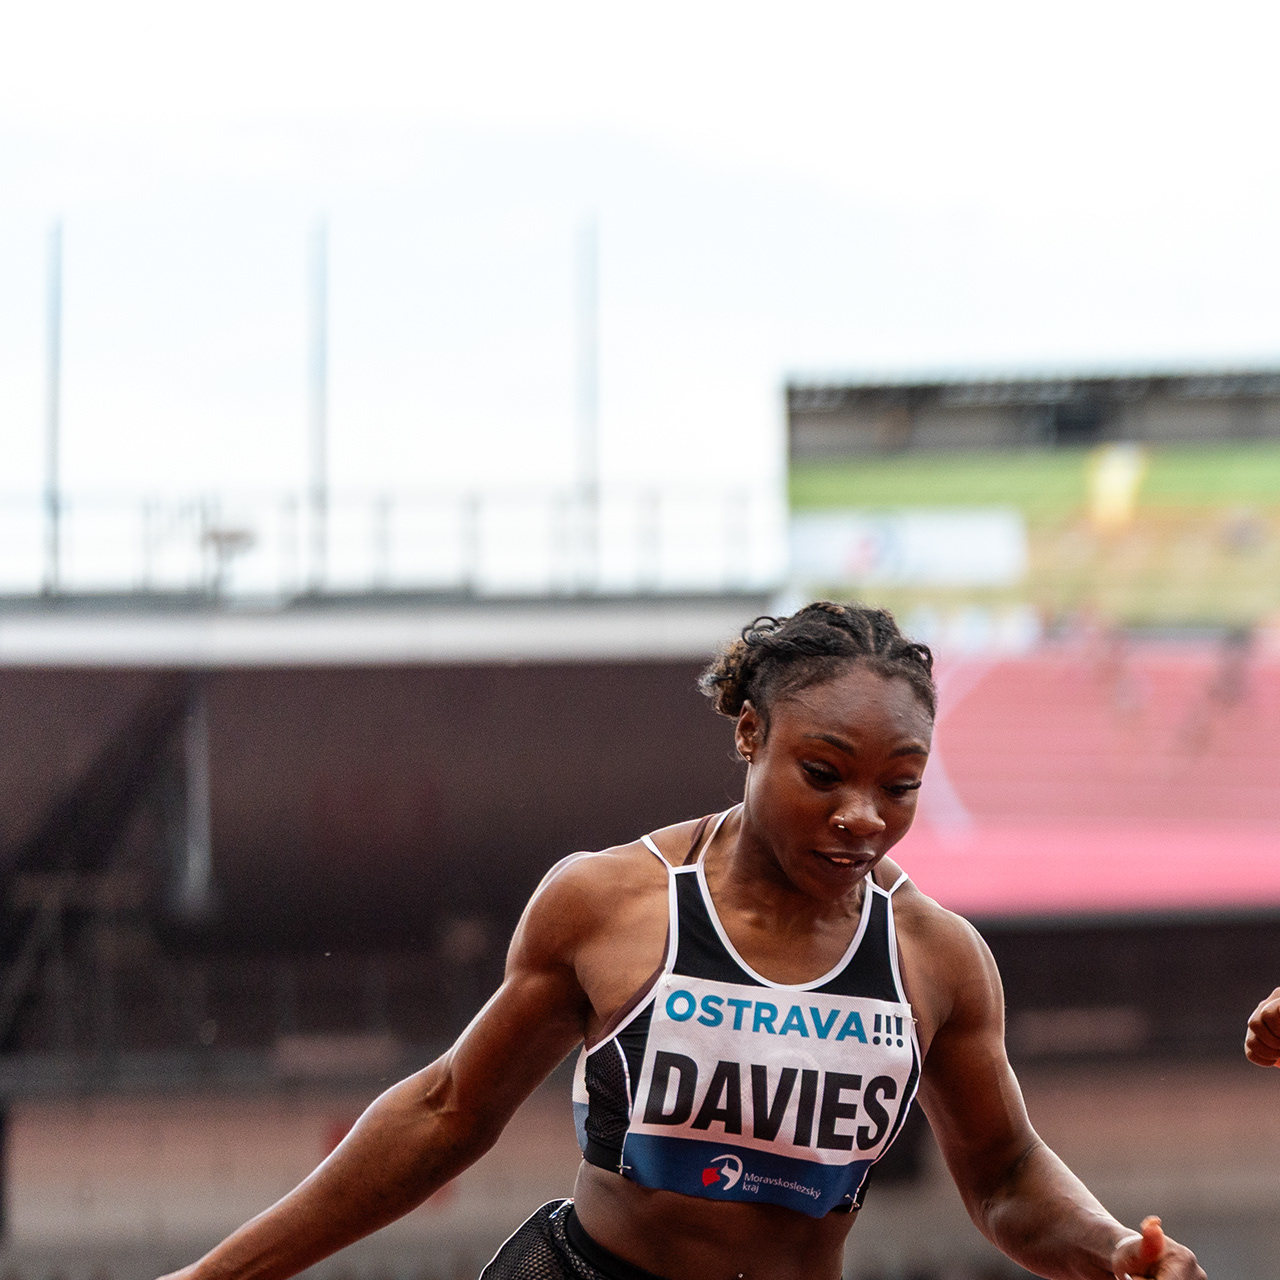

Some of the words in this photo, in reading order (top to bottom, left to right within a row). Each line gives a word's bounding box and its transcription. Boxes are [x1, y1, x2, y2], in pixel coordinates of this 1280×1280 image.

[666, 989, 904, 1048] OSTRAVA!!!
[642, 1050, 898, 1151] DAVIES
[742, 1181, 760, 1194] kraj
[744, 1172, 821, 1200] Moravskoslezský
